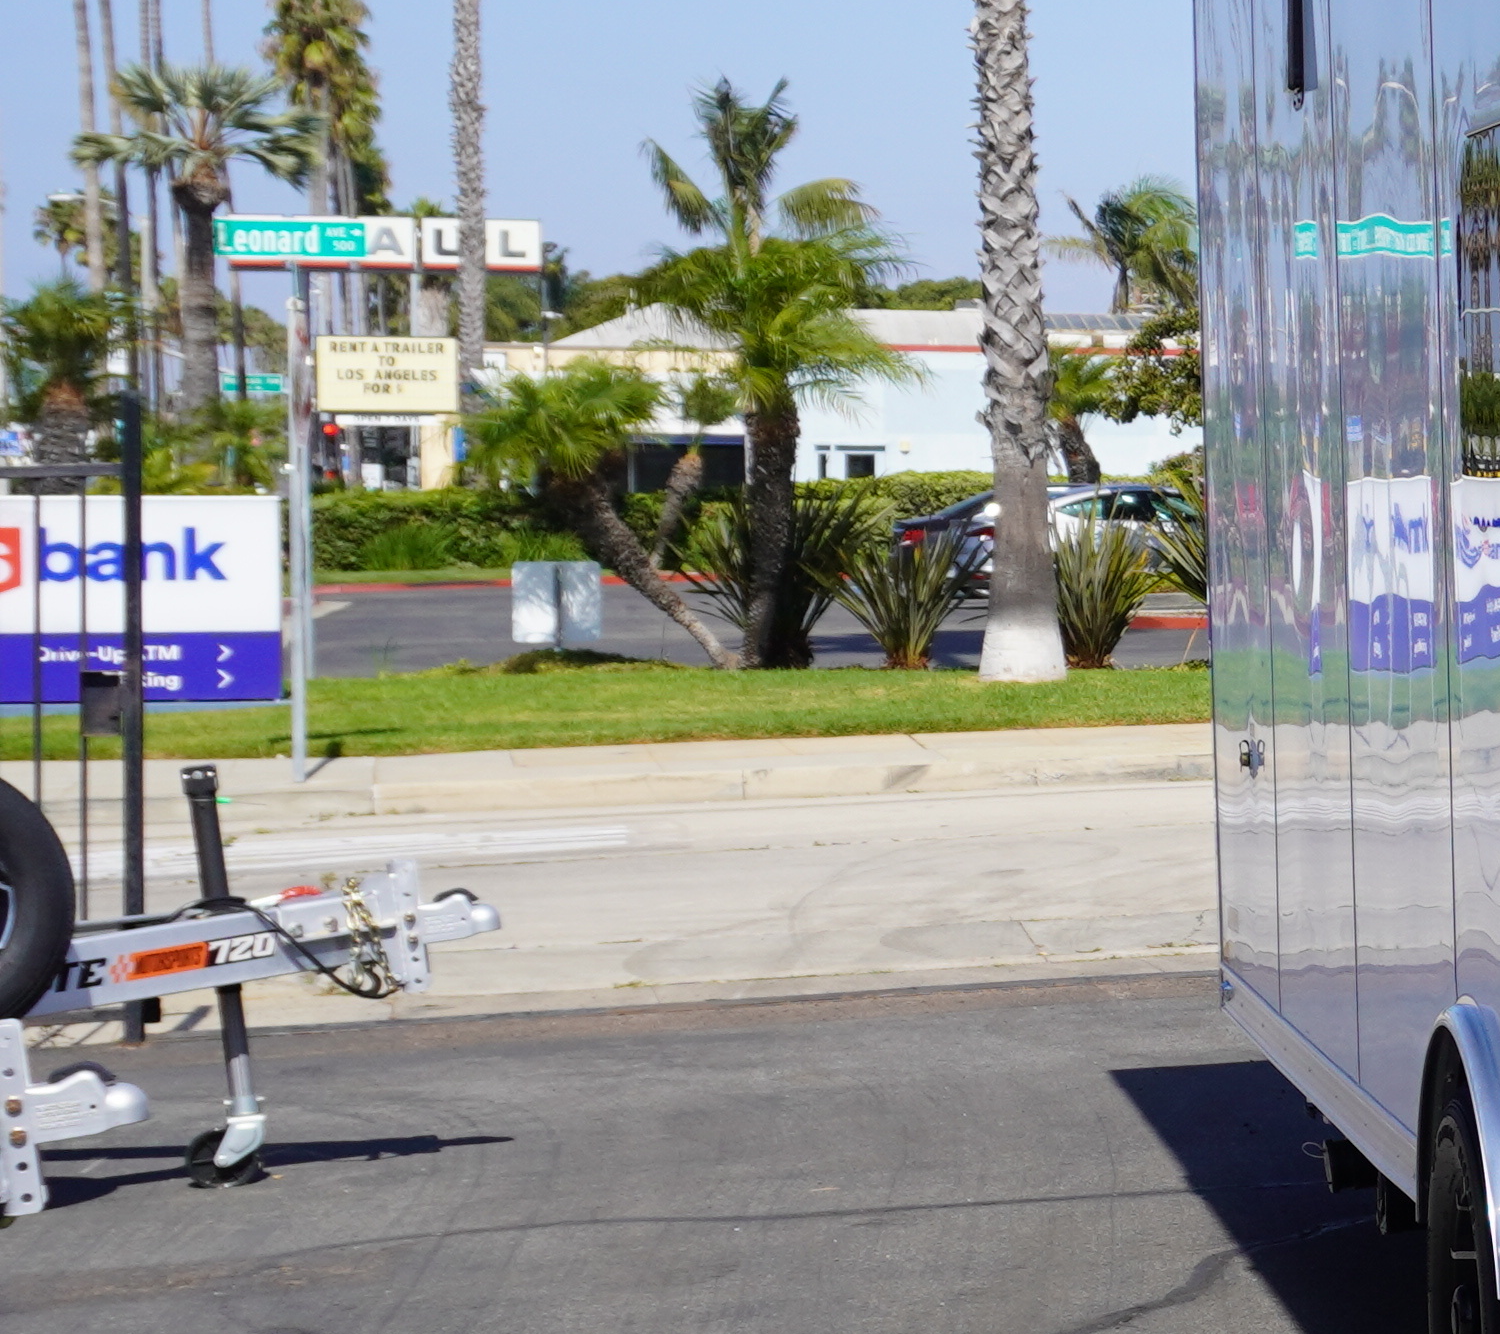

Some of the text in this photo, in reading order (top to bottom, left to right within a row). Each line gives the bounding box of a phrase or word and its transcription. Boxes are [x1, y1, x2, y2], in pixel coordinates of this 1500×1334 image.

[217, 222, 347, 254] Leonard AVE
[333, 240, 355, 252] 500
[329, 341, 444, 354] RENT A TRAILER
[379, 355, 395, 367] TO
[336, 369, 437, 382] LOS ANGELES
[363, 383, 390, 394] FOR
[38, 527, 227, 582] bank
[208, 932, 276, 965] 720
